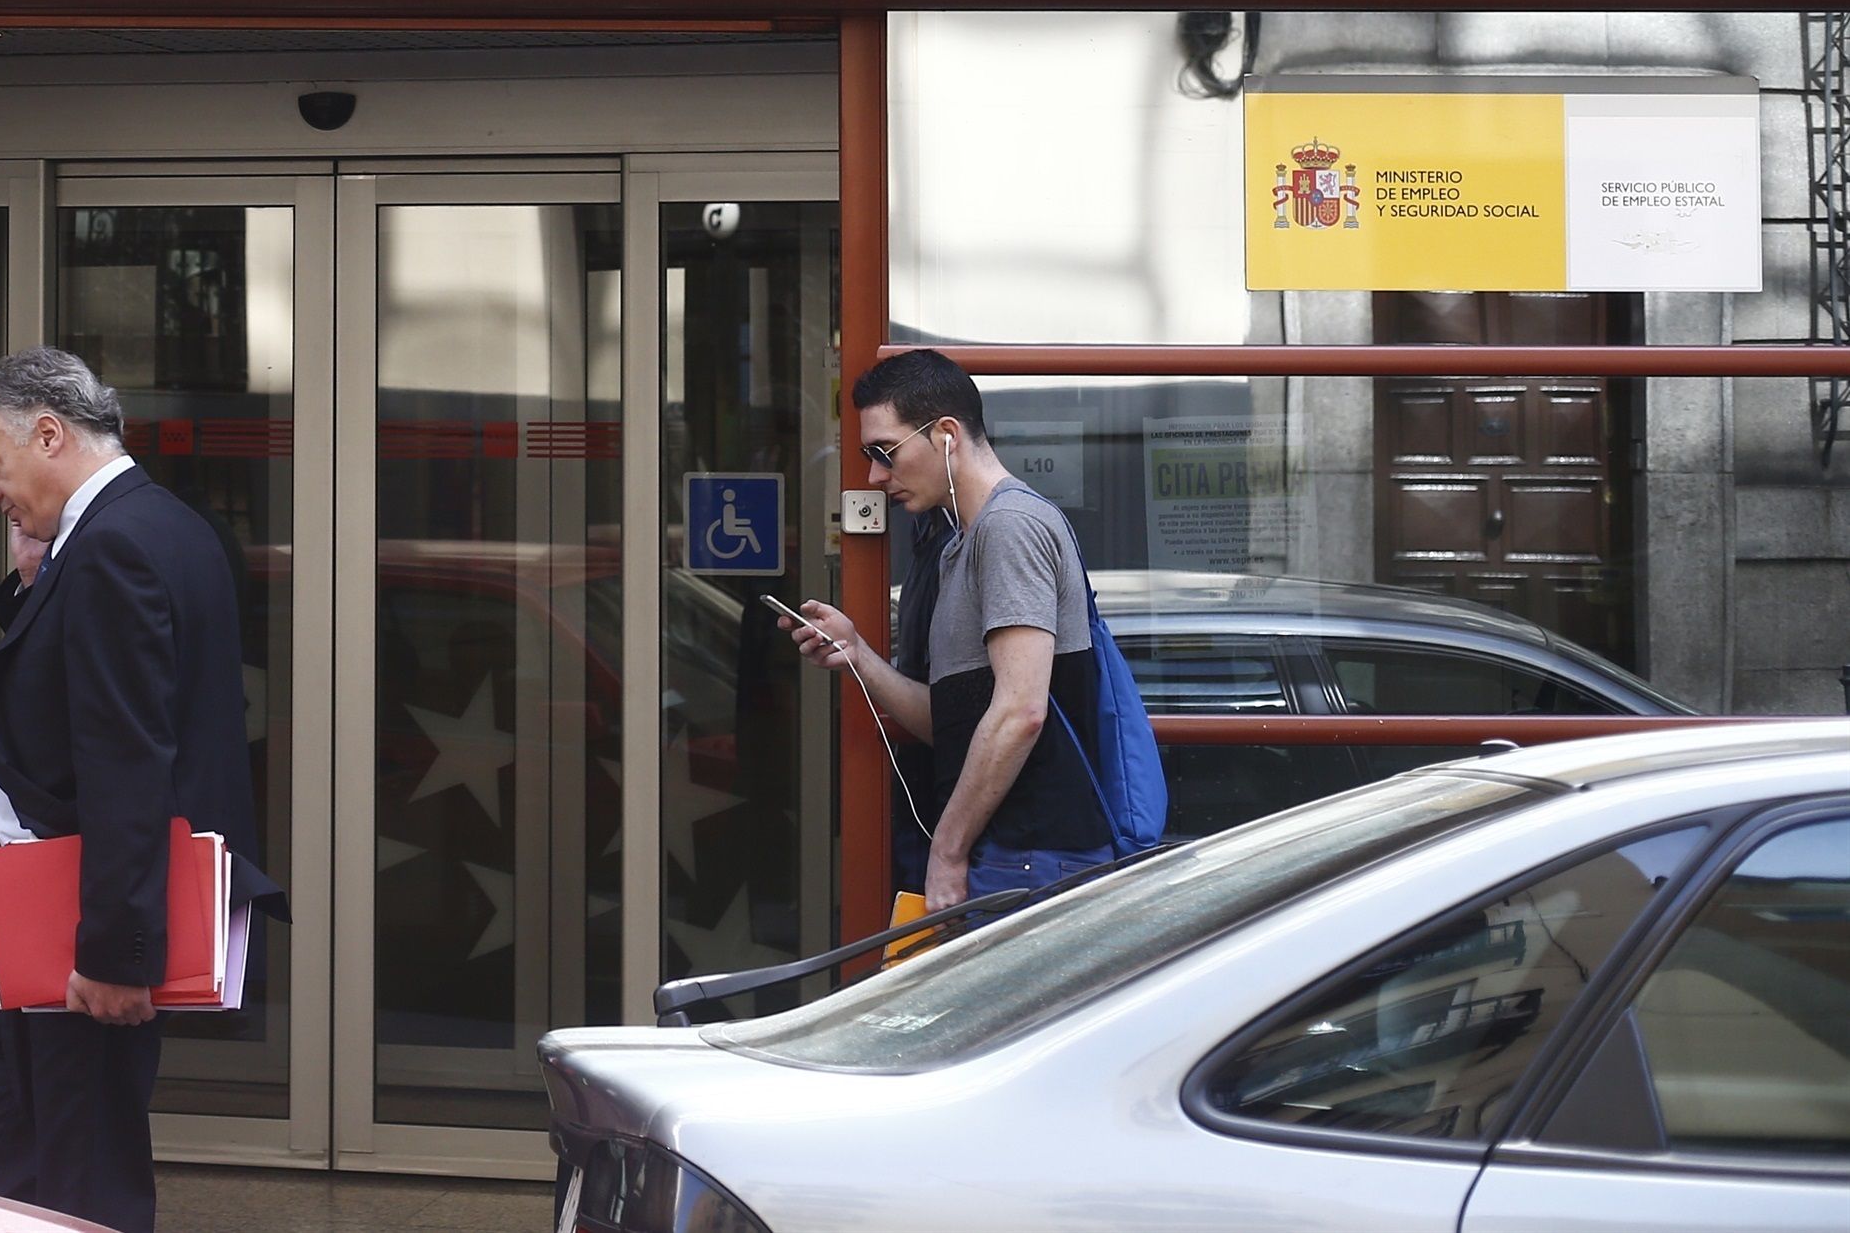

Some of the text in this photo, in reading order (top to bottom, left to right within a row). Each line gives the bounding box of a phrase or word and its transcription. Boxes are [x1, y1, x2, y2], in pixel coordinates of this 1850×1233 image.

[1375, 170, 1463, 184] MINISTERIO
[1601, 179, 1716, 194] SERVICIO PÚBLICO
[1376, 187, 1461, 201] DE EMPLEO
[1602, 196, 1726, 207] DE EMPLEO ESTATAL
[1376, 204, 1540, 218] Y SEGURIDAD SOCIAL
[1023, 457, 1055, 474] L10
[1156, 462, 1211, 497] CITA
